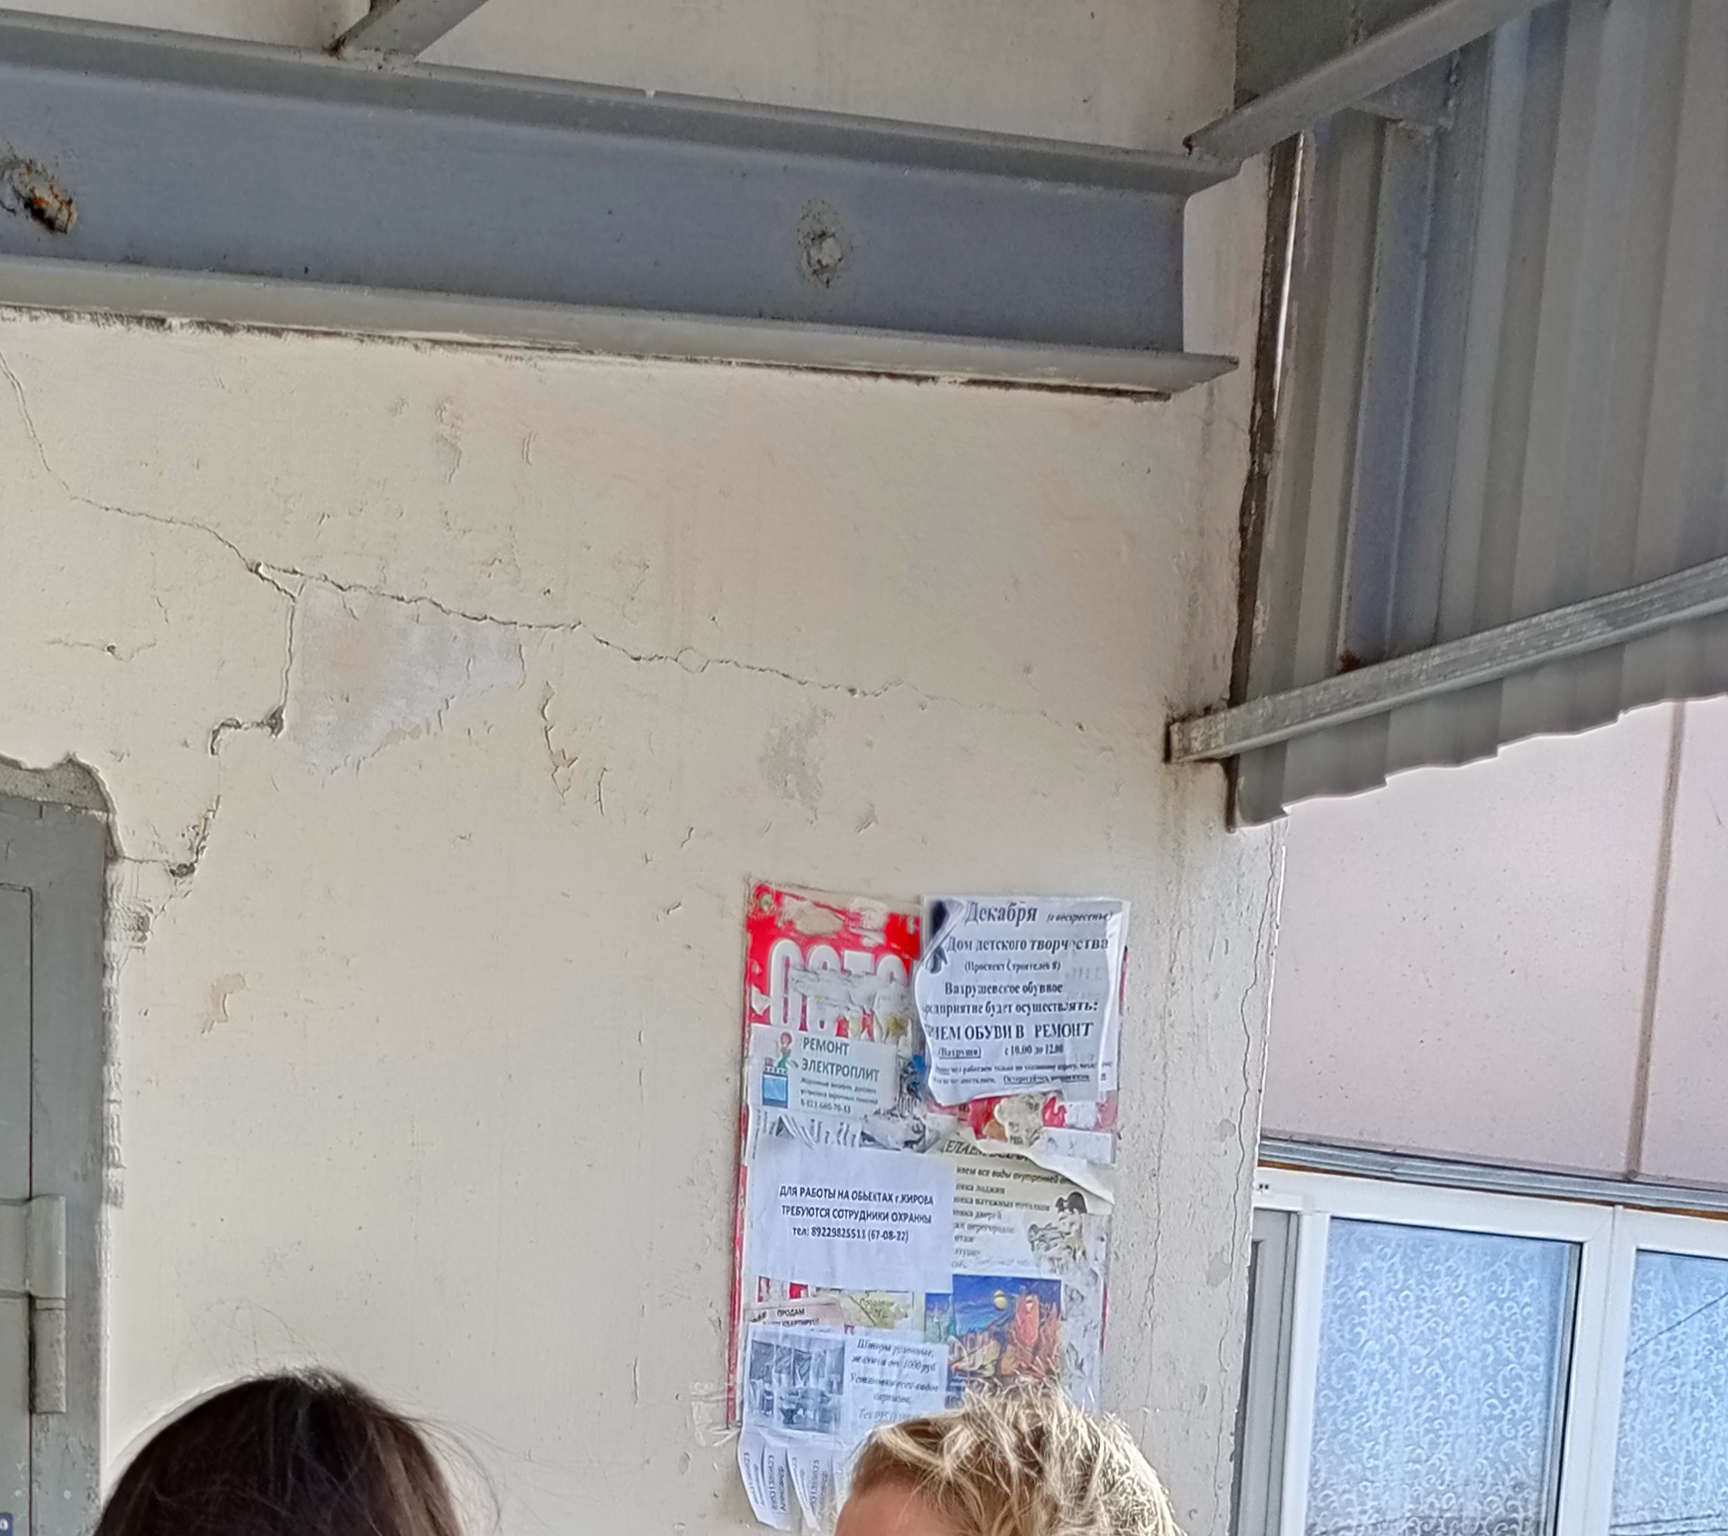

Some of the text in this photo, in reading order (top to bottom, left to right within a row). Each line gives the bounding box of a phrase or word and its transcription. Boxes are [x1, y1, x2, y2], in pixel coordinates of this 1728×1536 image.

[965, 901, 1039, 927] Декабря
[947, 936, 973, 952] Дом
[975, 938, 1027, 952] детского
[945, 981, 1064, 998] Вахрушевское обувное
[985, 1001, 1013, 1017] будет
[964, 1022, 1094, 1041] ОБУВИ В РЕМОНТ
[802, 1036, 850, 1057] РЕМОНТ
[801, 1058, 881, 1083] ЭЛЕКТРОПЛИТ
[779, 1185, 798, 1197] ДЛЯ
[799, 1187, 836, 1200] РАБОТЫ
[837, 1190, 850, 1200] НА
[781, 1205, 830, 1218] ТРЕБУЮТСЯ
[832, 1208, 890, 1222] СОТРУДНИКИ
[792, 1227, 809, 1237] тел:
